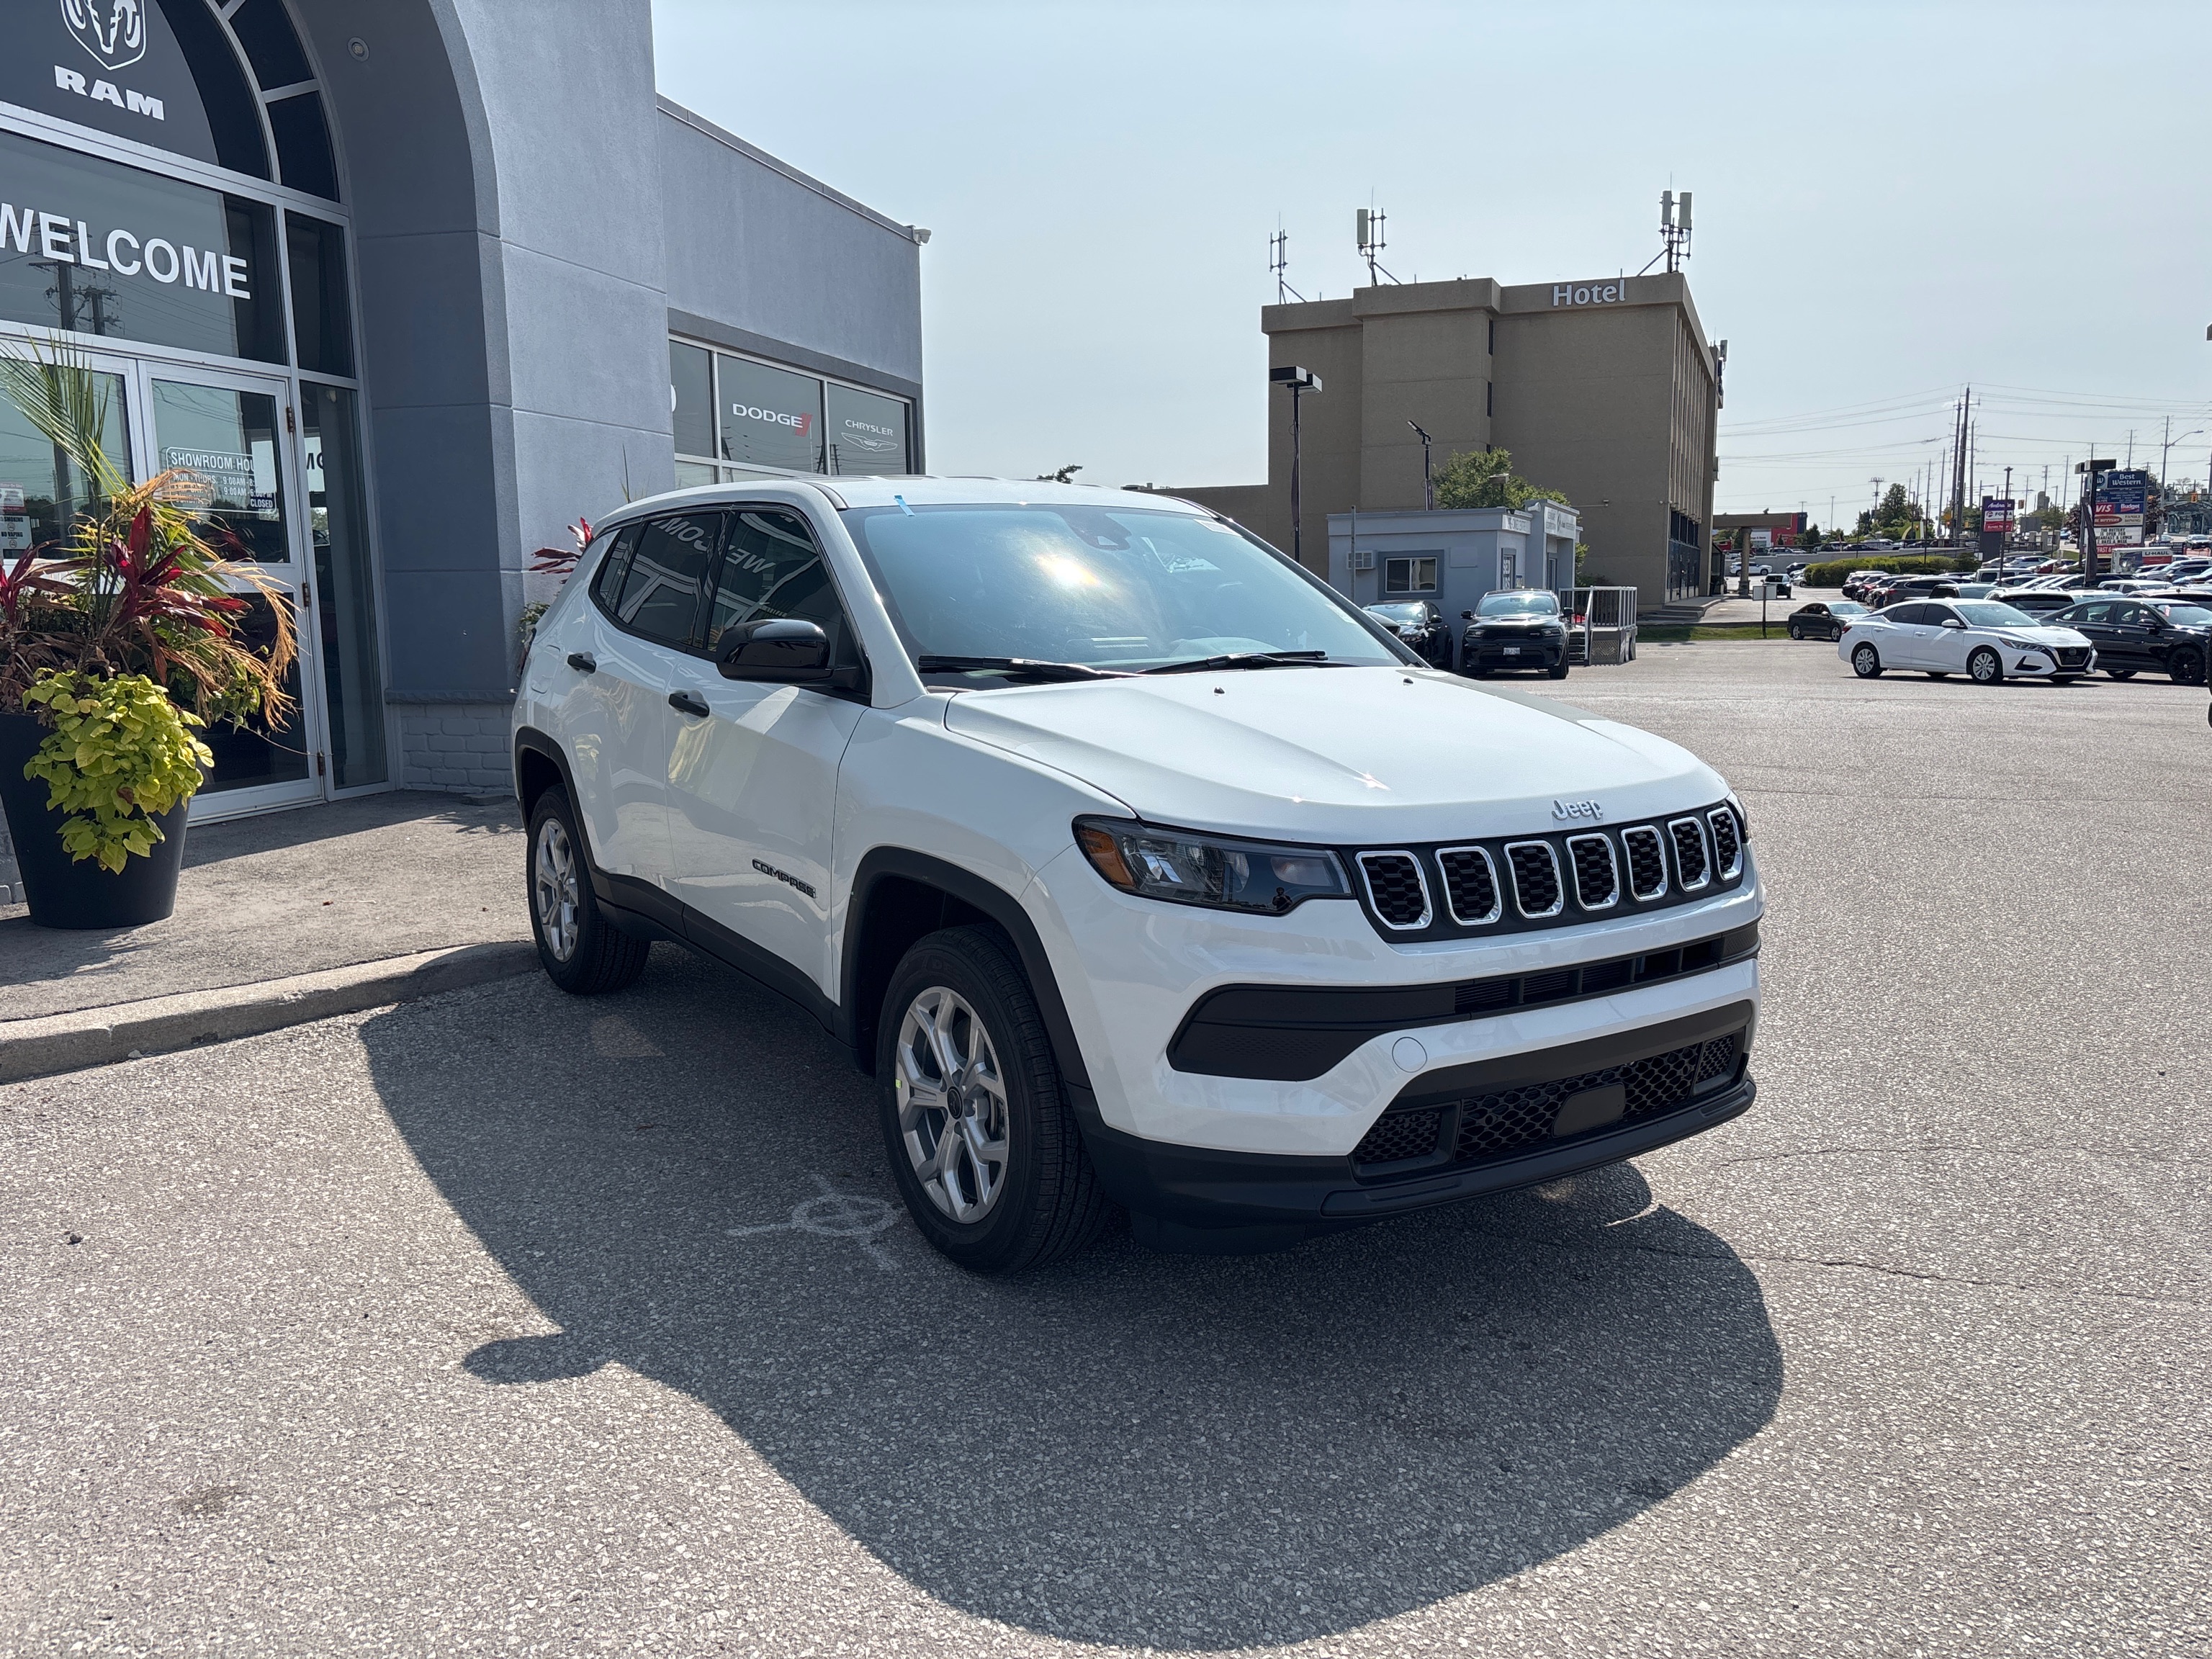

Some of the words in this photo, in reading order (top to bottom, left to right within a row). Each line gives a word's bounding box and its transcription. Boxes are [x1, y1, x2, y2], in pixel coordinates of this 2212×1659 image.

[55, 65, 165, 121] RAM
[0, 203, 251, 300] WELCOME
[1553, 279, 1626, 306] Hotel
[732, 403, 803, 428] DODGE
[845, 419, 893, 436] CHRYSLER
[171, 452, 233, 469] SHOWROOM
[250, 498, 273, 508] CLOSED
[1552, 799, 1604, 821] Jeep
[752, 858, 817, 899] COMPASS
